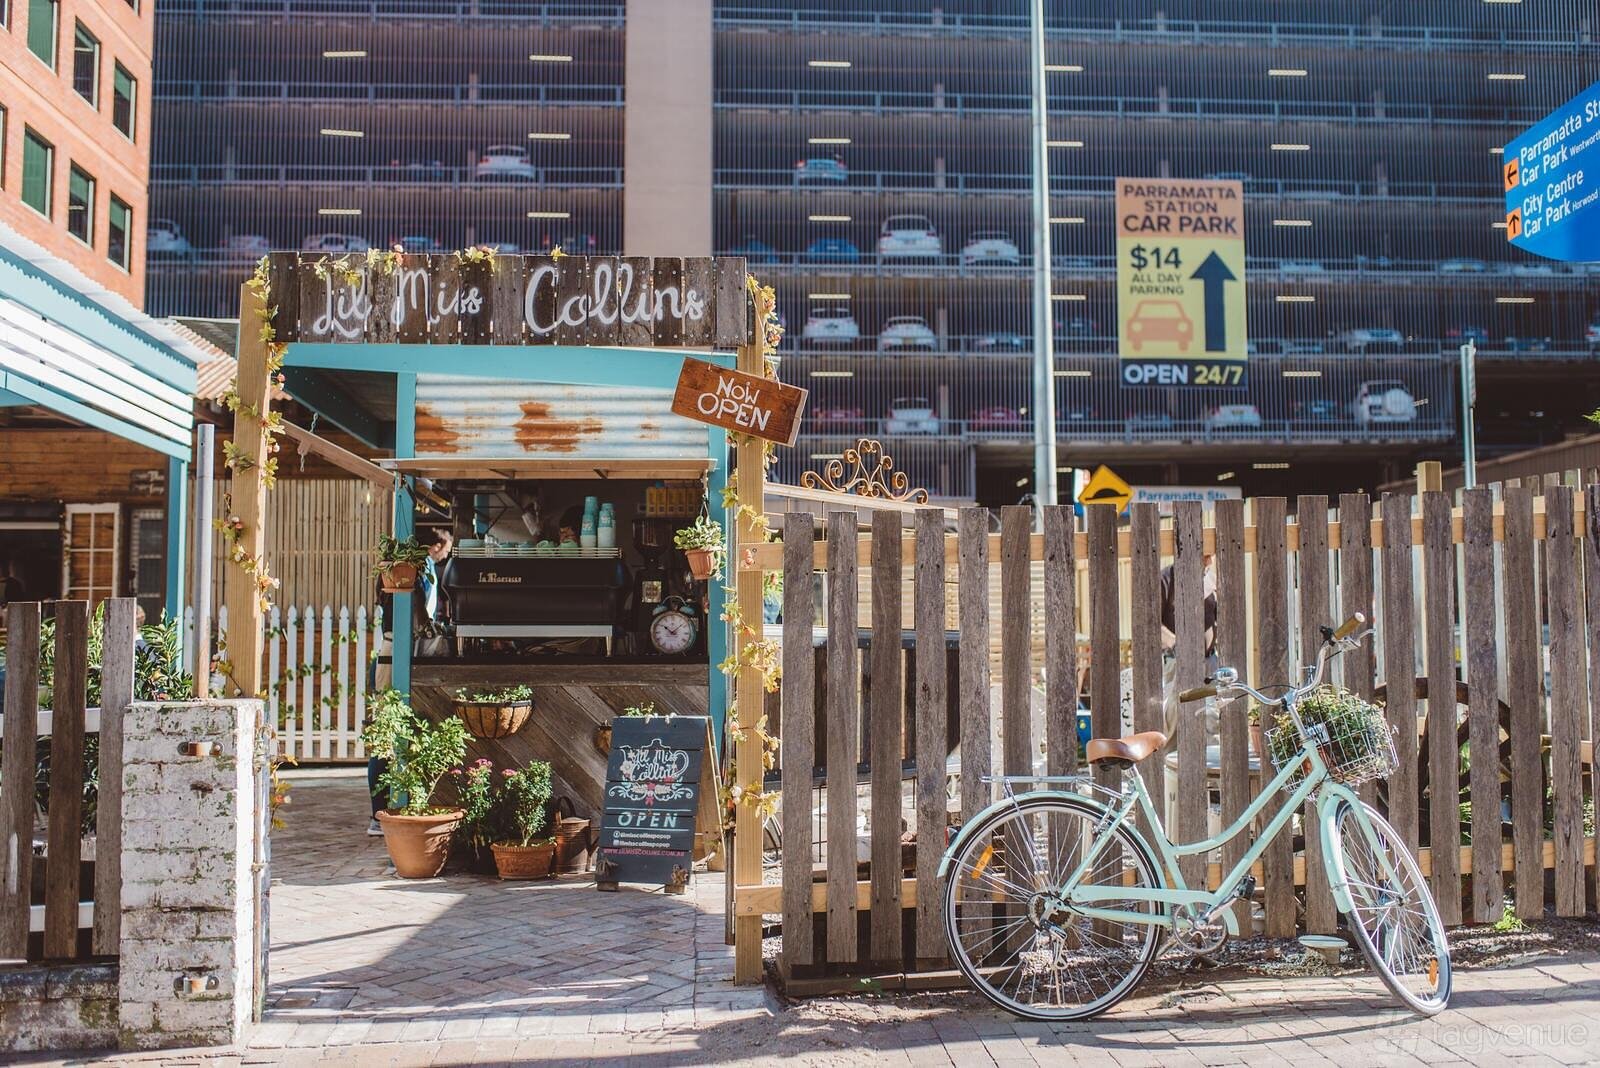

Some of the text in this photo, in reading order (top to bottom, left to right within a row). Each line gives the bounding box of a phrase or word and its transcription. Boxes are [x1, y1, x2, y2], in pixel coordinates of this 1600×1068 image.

[1520, 115, 1582, 166] Parramatta
[1522, 164, 1539, 187] Car
[1543, 144, 1568, 173] Park
[1124, 184, 1236, 200] PARRAMATTA
[1523, 169, 1584, 216] City Centre
[1145, 201, 1217, 214] STATION
[1524, 187, 1599, 239] Car Park Horwood
[1124, 215, 1237, 234] CAR PARK
[1130, 244, 1182, 272] $14
[1132, 274, 1182, 284] ALL DAY
[312, 263, 704, 337] Lil Miss Collins
[1130, 285, 1184, 295] PARKING
[1124, 364, 1243, 385] OPEN 24/7
[697, 392, 772, 432] OPEN
[1138, 489, 1227, 502] Parramatta Stn
[618, 811, 678, 828] OPEN
